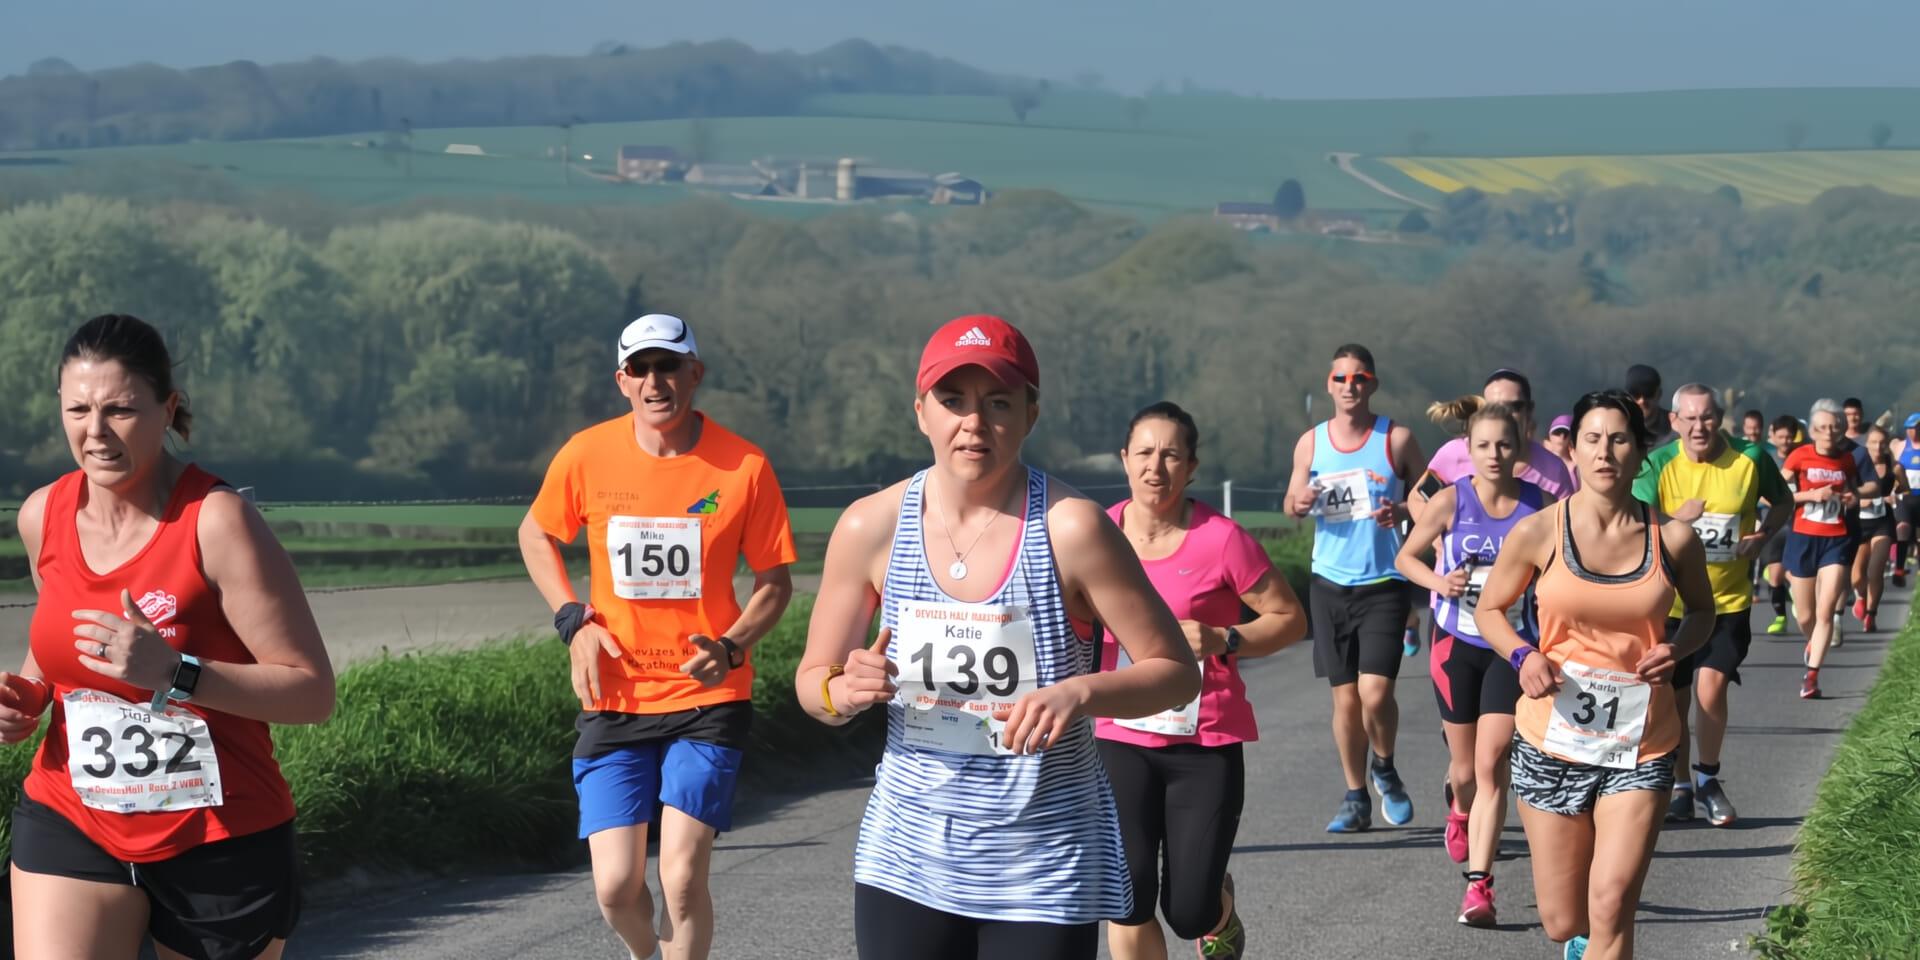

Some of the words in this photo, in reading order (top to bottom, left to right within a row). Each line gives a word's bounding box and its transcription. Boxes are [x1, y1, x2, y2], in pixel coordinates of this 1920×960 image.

[955, 338, 991, 346] adidas
[1326, 486, 1356, 509] 44
[640, 531, 665, 541] Mike
[617, 543, 690, 577] 150
[915, 609, 947, 620] DEVIZES
[949, 611, 969, 621] HALF
[971, 613, 1013, 624] MARATHON
[945, 624, 983, 640] Katie
[910, 642, 1020, 697] 139
[1589, 681, 1617, 693] Karla
[119, 707, 152, 724] Tina
[1571, 692, 1620, 729] 31
[81, 725, 202, 779] 332
[1607, 752, 1623, 764] 31
